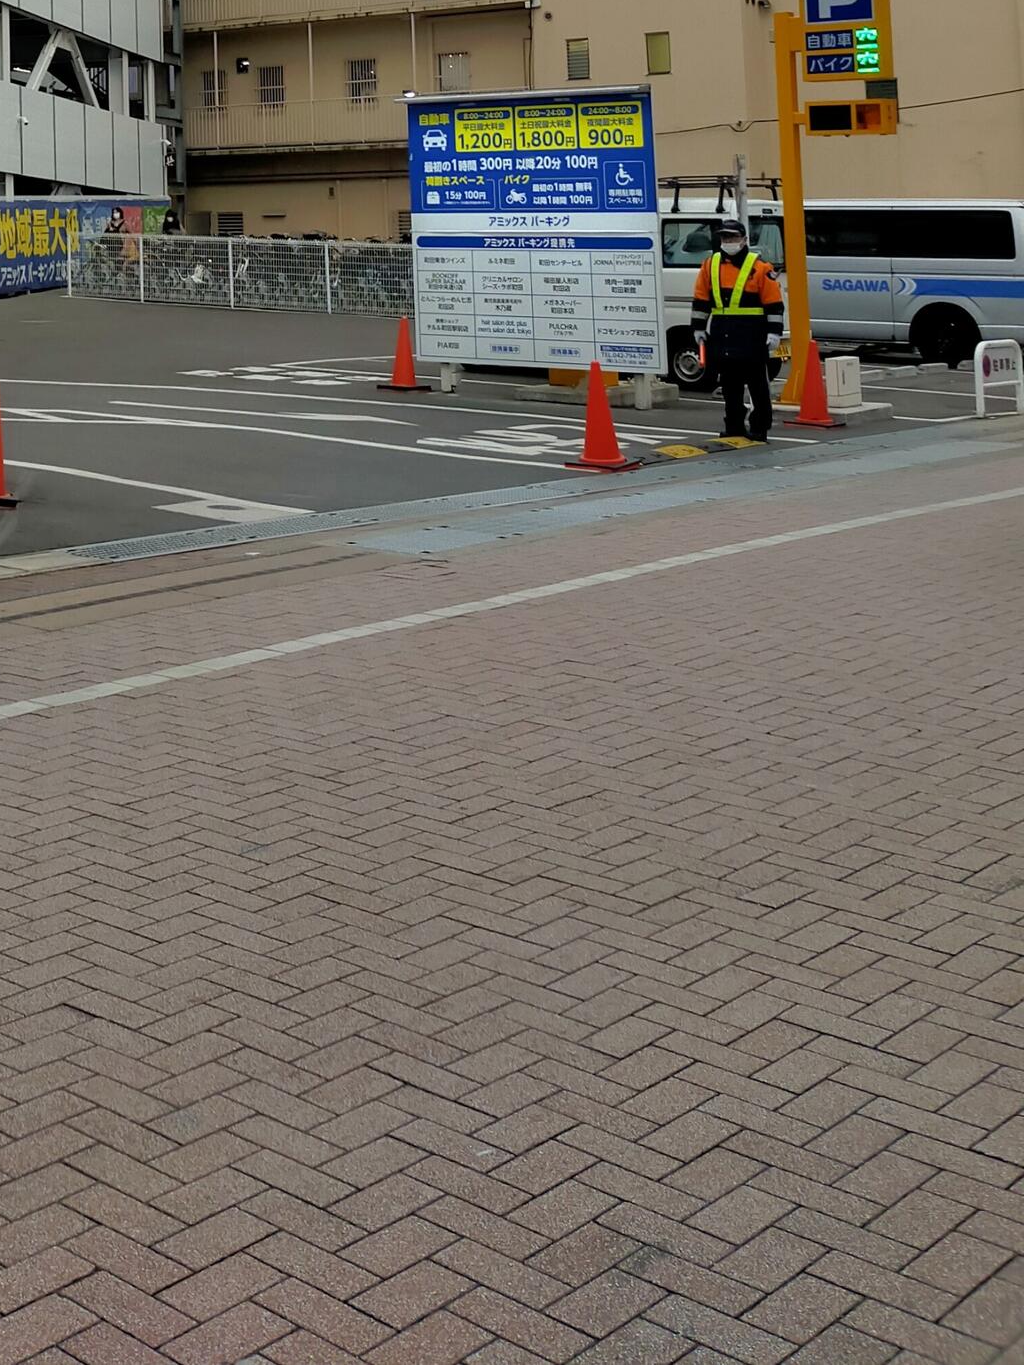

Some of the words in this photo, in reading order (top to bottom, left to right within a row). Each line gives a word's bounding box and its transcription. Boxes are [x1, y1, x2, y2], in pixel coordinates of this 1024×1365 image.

[807, 33, 852, 49] 自動車
[855, 28, 879, 49] 空
[810, 57, 853, 72] バイク
[856, 52, 880, 73] 空
[419, 113, 450, 126] 自動車
[458, 132, 512, 150] 1,200円
[519, 130, 576, 148] 1,800円
[588, 128, 635, 146] 900円
[424, 159, 478, 173] 最初の1時間
[479, 157, 513, 171] 300円
[515, 156, 562, 171] 以降20分
[565, 155, 598, 169] 100円
[504, 175, 530, 185] バイク
[445, 190, 462, 200] 15分
[464, 190, 487, 200] 100円
[569, 194, 593, 205] 100円
[488, 216, 527, 227] アミックス
[530, 216, 570, 227] パーキング
[483, 238, 516, 248] アミックス
[0, 264, 27, 287] アミックス
[28, 260, 55, 284] パーキング
[822, 279, 890, 292] SAGAWA
